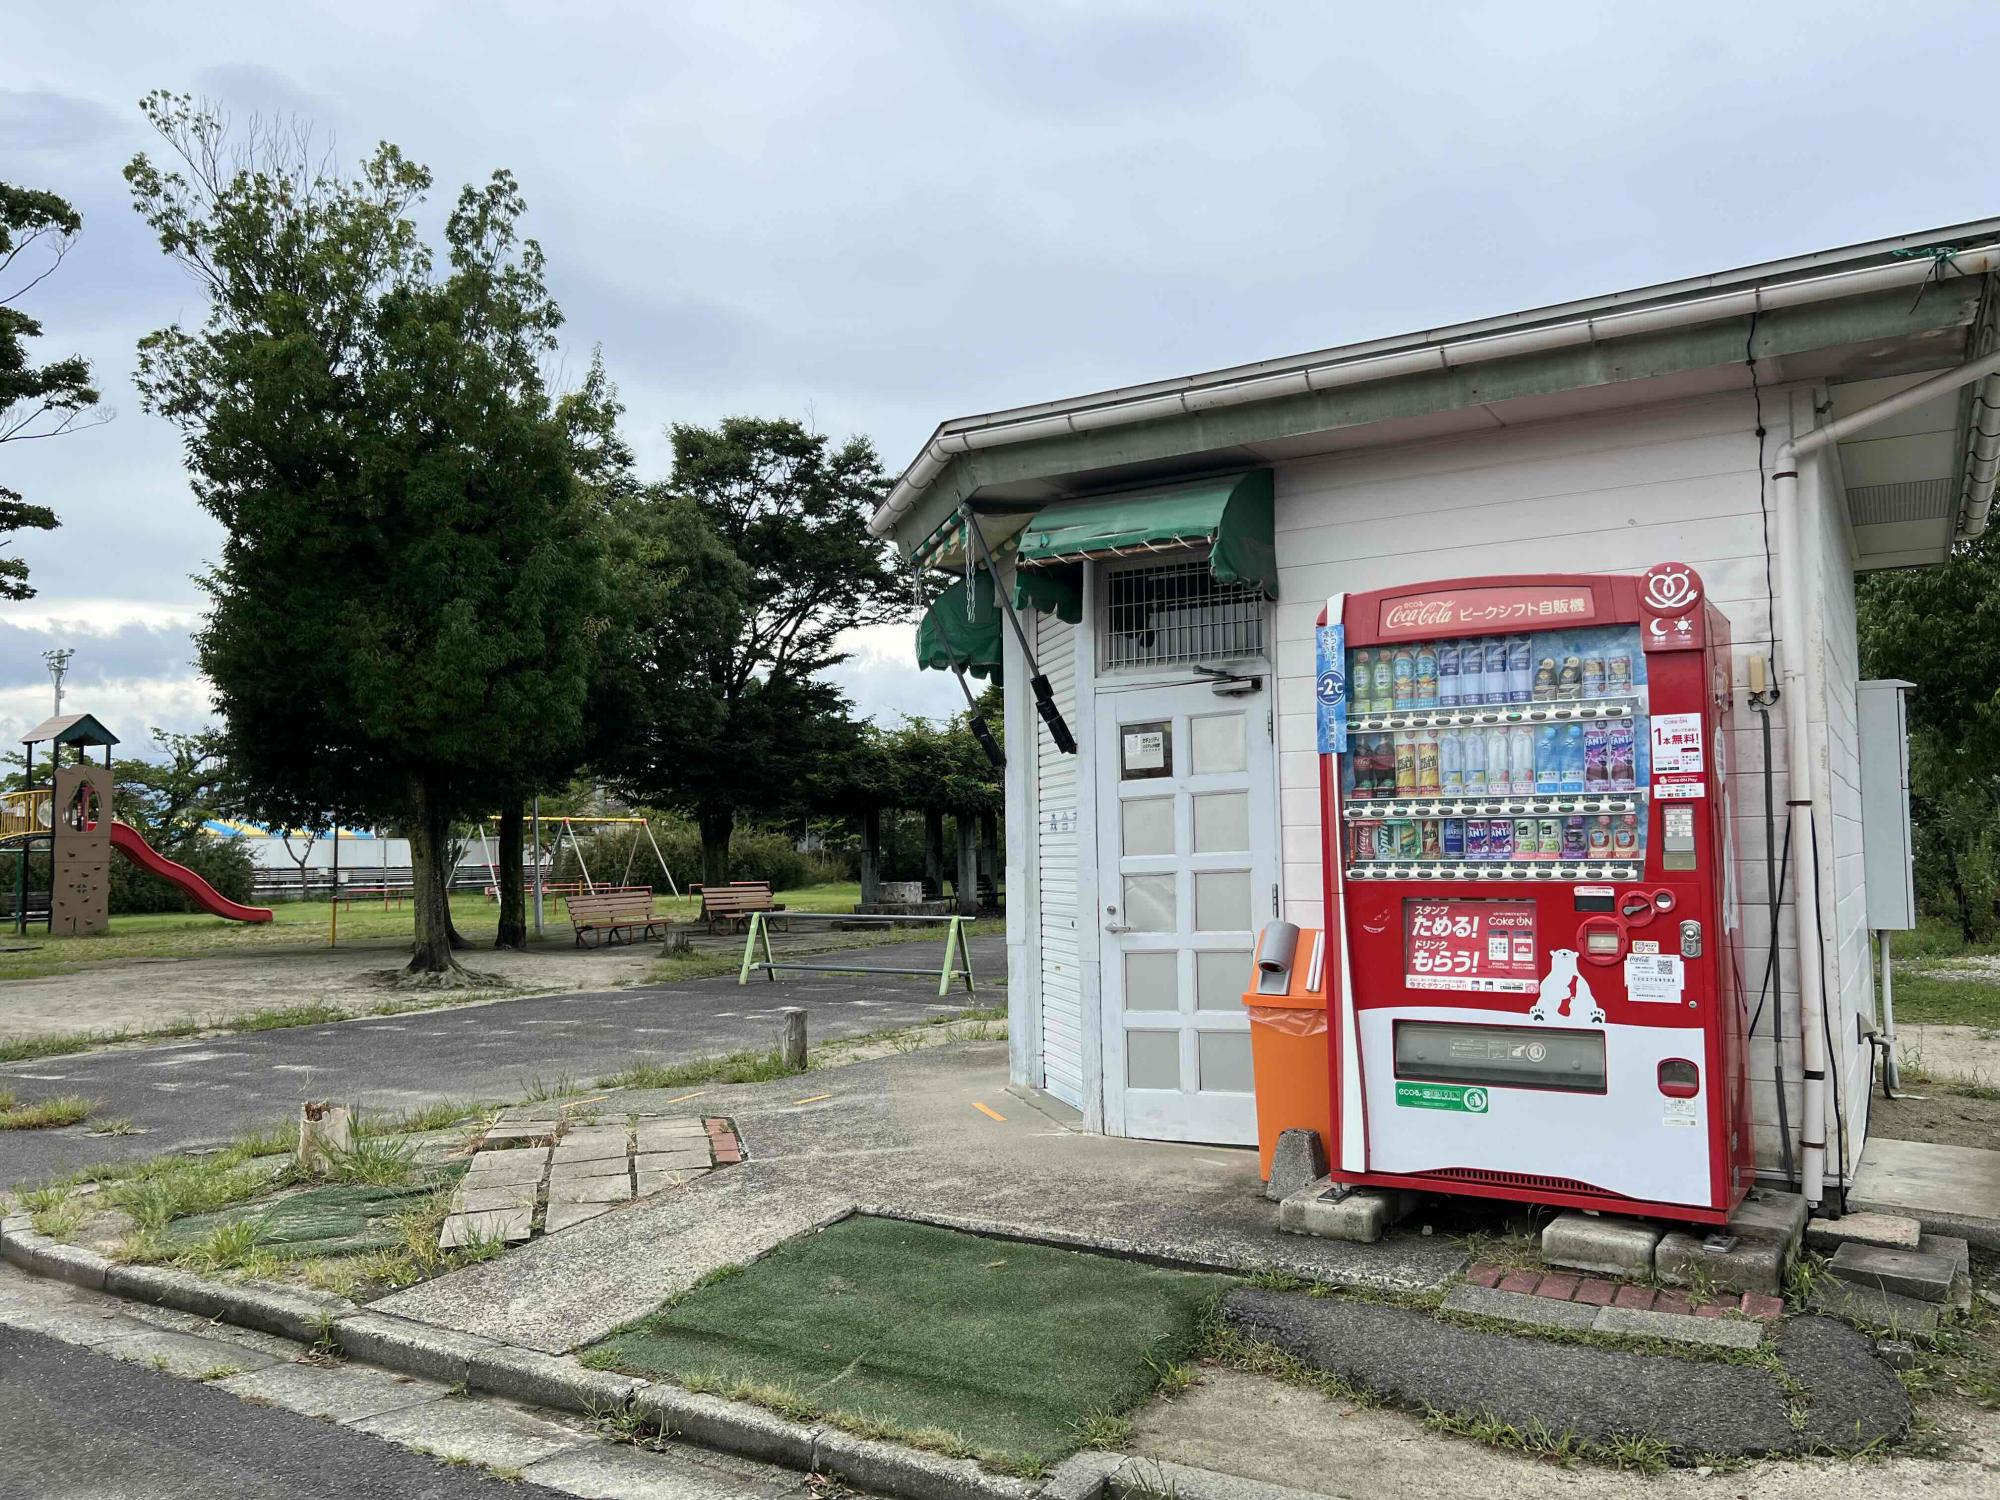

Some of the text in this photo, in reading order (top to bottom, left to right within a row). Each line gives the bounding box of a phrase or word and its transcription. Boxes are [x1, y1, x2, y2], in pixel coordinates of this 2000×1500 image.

[1460, 597, 1585, 622] ピークシフト自販機
[1415, 905, 1449, 915] スタンプ
[1412, 915, 1480, 938] ためる!
[1488, 915, 1533, 926] Coke ON
[1415, 940, 1448, 950] ドリンク
[1412, 949, 1480, 973] もらう!
